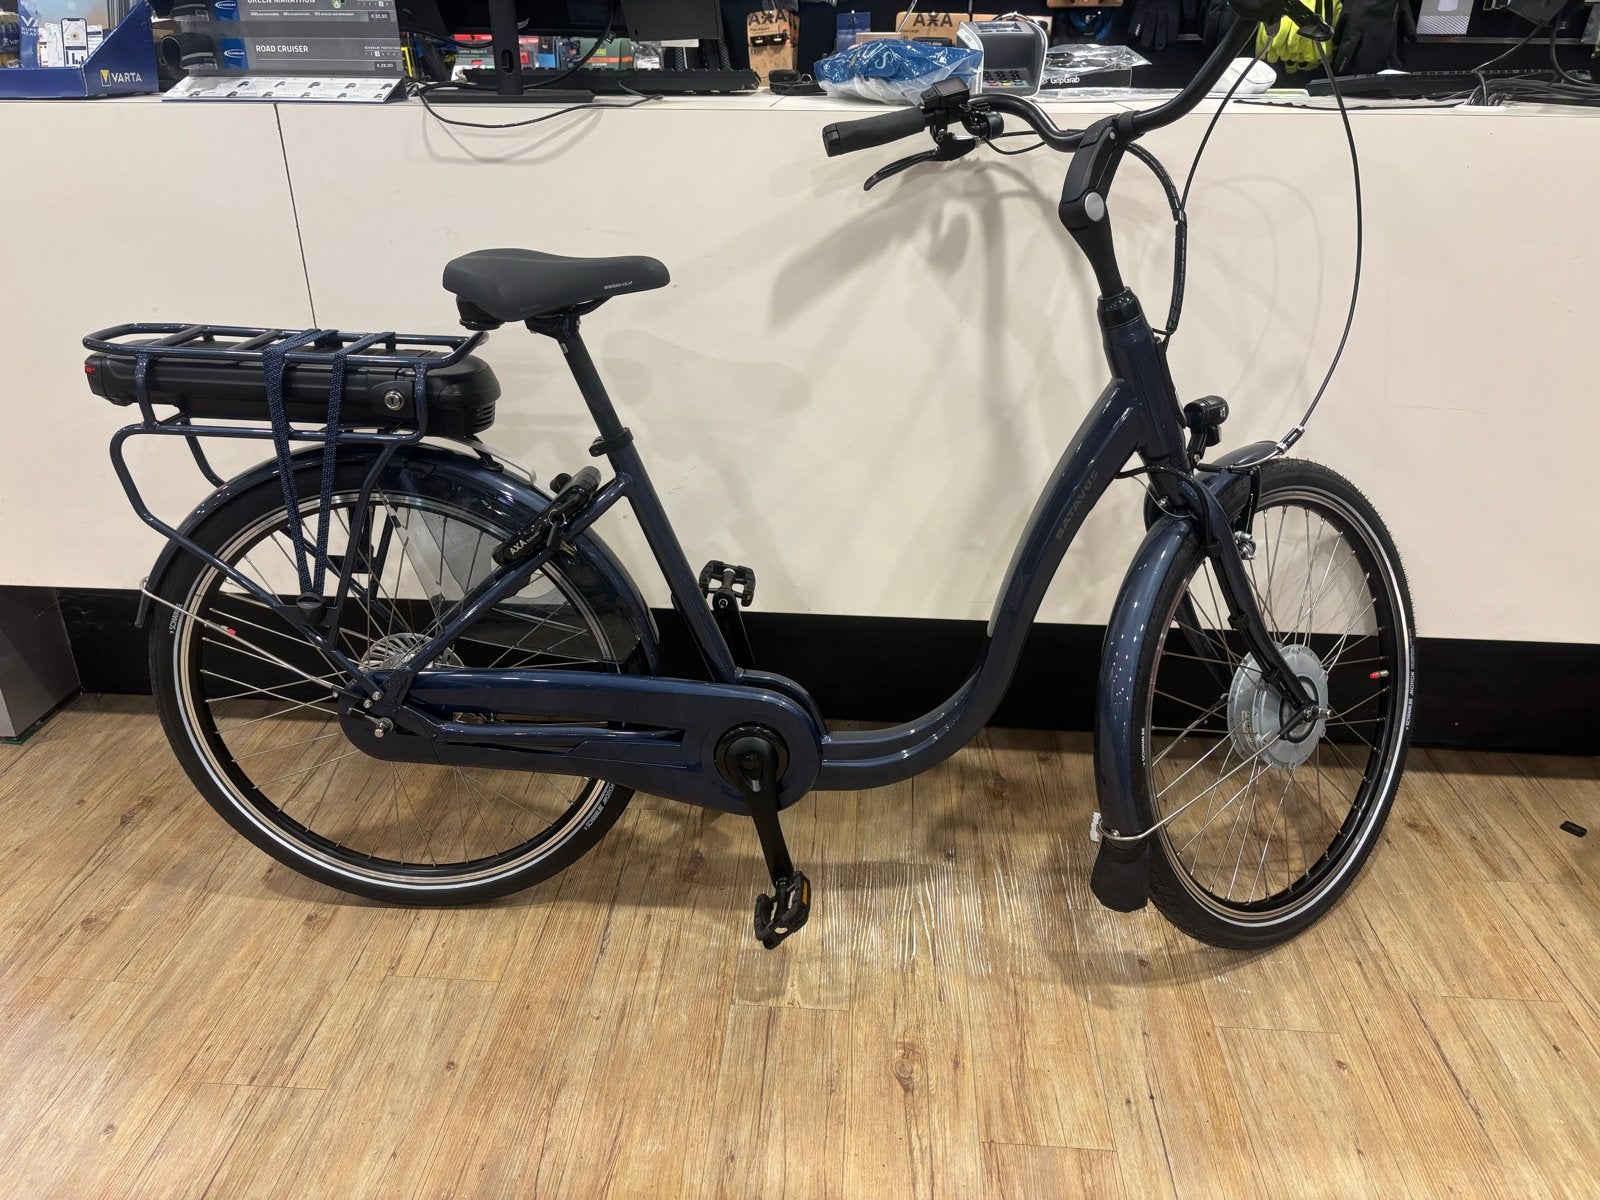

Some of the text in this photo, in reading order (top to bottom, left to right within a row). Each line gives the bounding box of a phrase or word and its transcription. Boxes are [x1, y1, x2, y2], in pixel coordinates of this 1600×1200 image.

[749, 10, 788, 26] AXA
[913, 13, 953, 27] AXA
[255, 45, 309, 53] ROAD CRUISER
[111, 72, 143, 83] VARTA
[1051, 75, 1080, 85] GripGrab
[1055, 471, 1099, 540] BATAVUS
[510, 540, 528, 555] AXA
